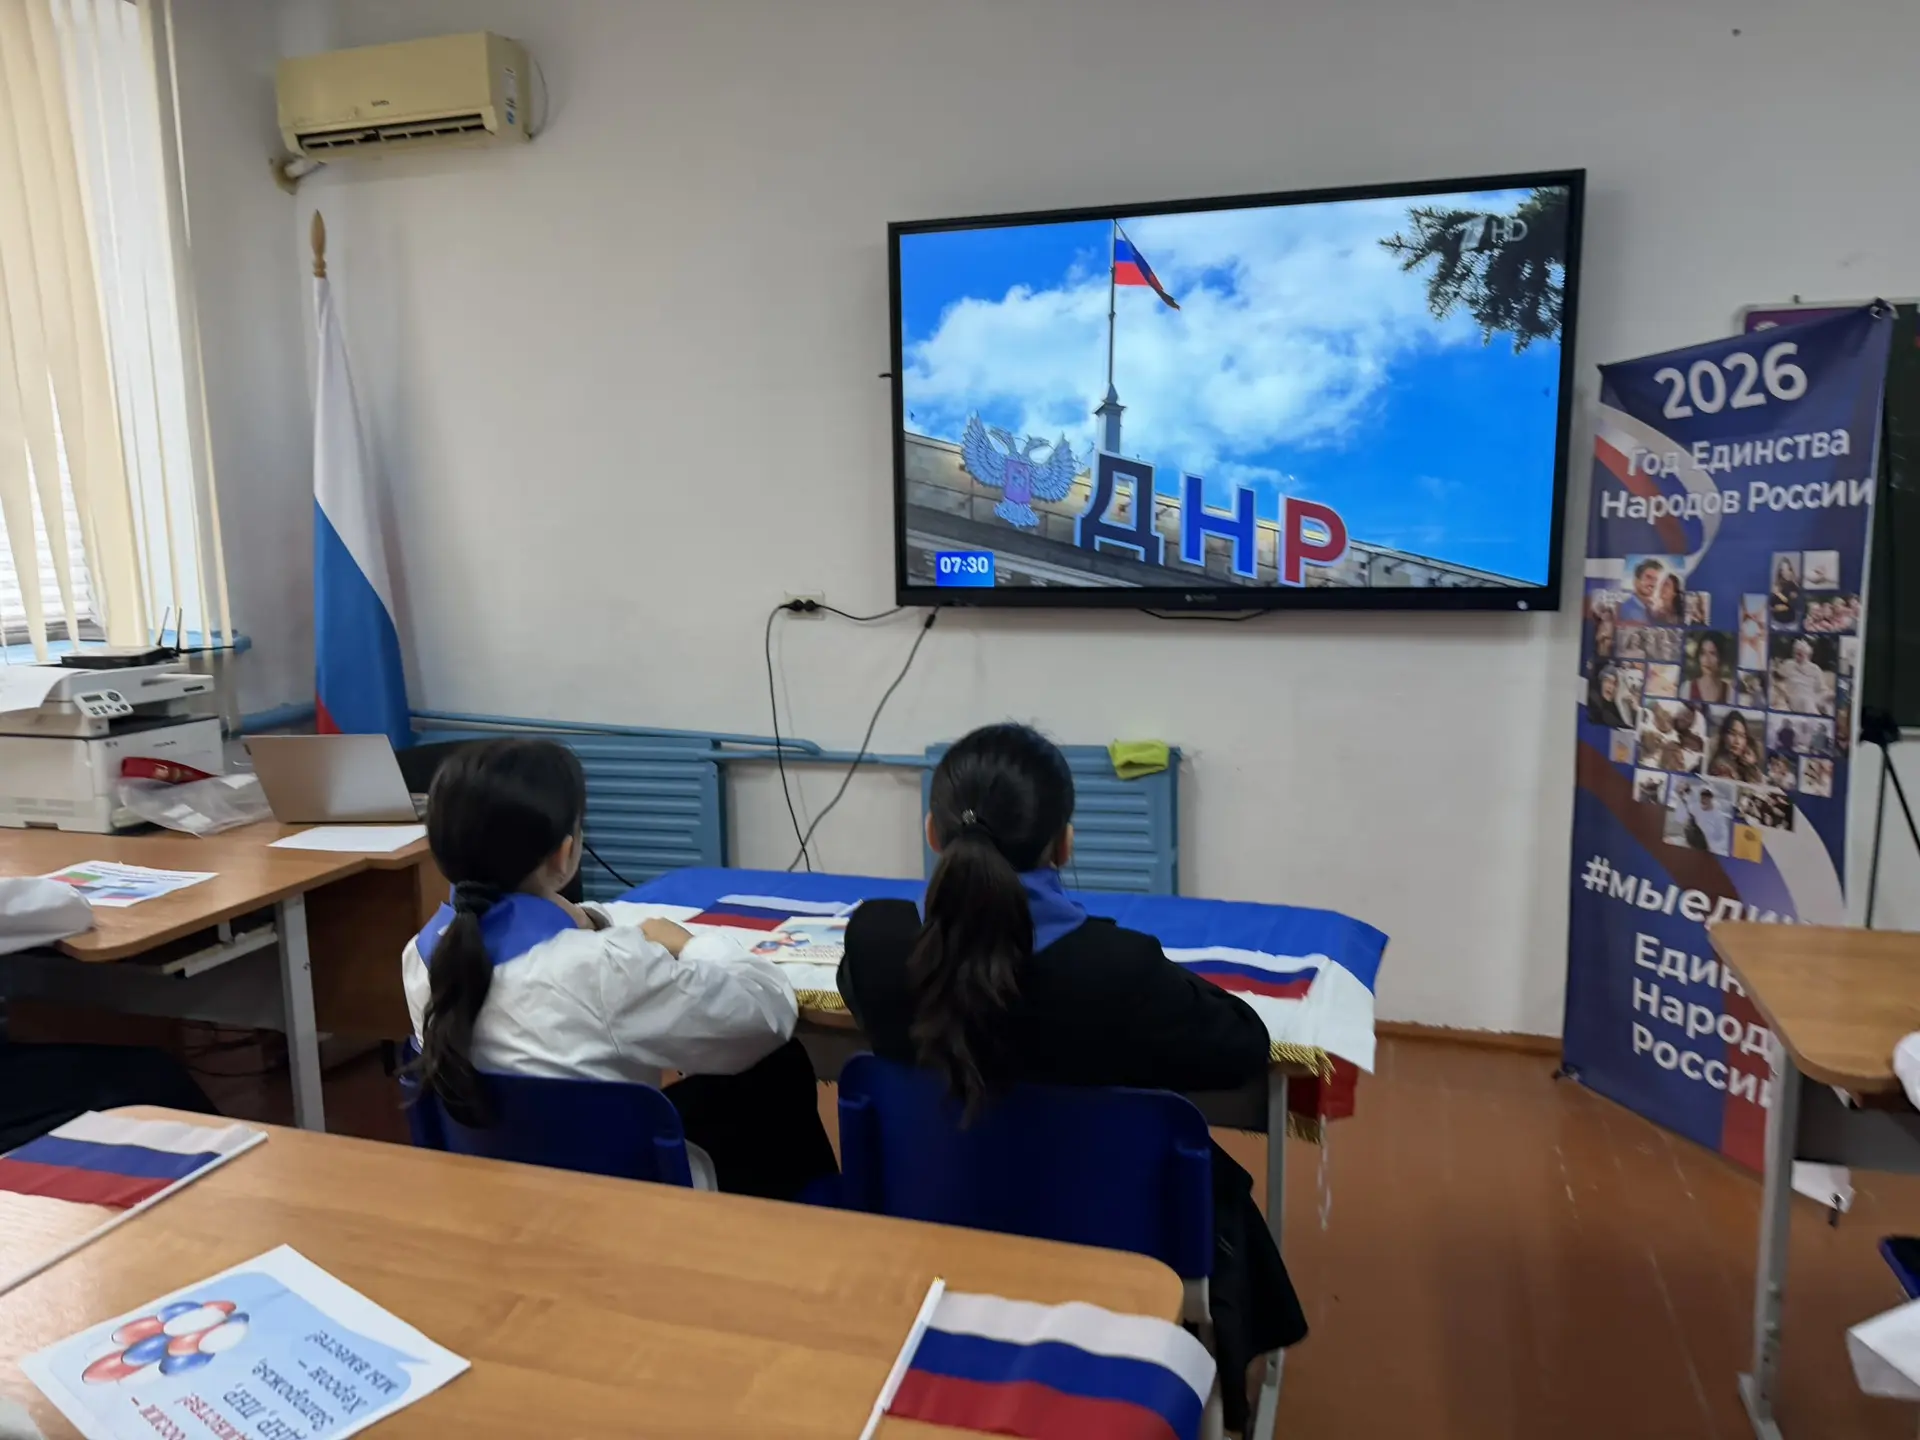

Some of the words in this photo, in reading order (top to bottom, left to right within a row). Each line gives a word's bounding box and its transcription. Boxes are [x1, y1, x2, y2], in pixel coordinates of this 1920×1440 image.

[1490, 217, 1529, 243] HD
[1653, 341, 1808, 420] 2026
[1627, 446, 1680, 478] Год
[1692, 428, 1850, 474] Единства
[1074, 450, 1349, 588] ДНР
[1601, 489, 1741, 525] Народов
[1747, 478, 1874, 514] России
[939, 555, 989, 574] 07:30
